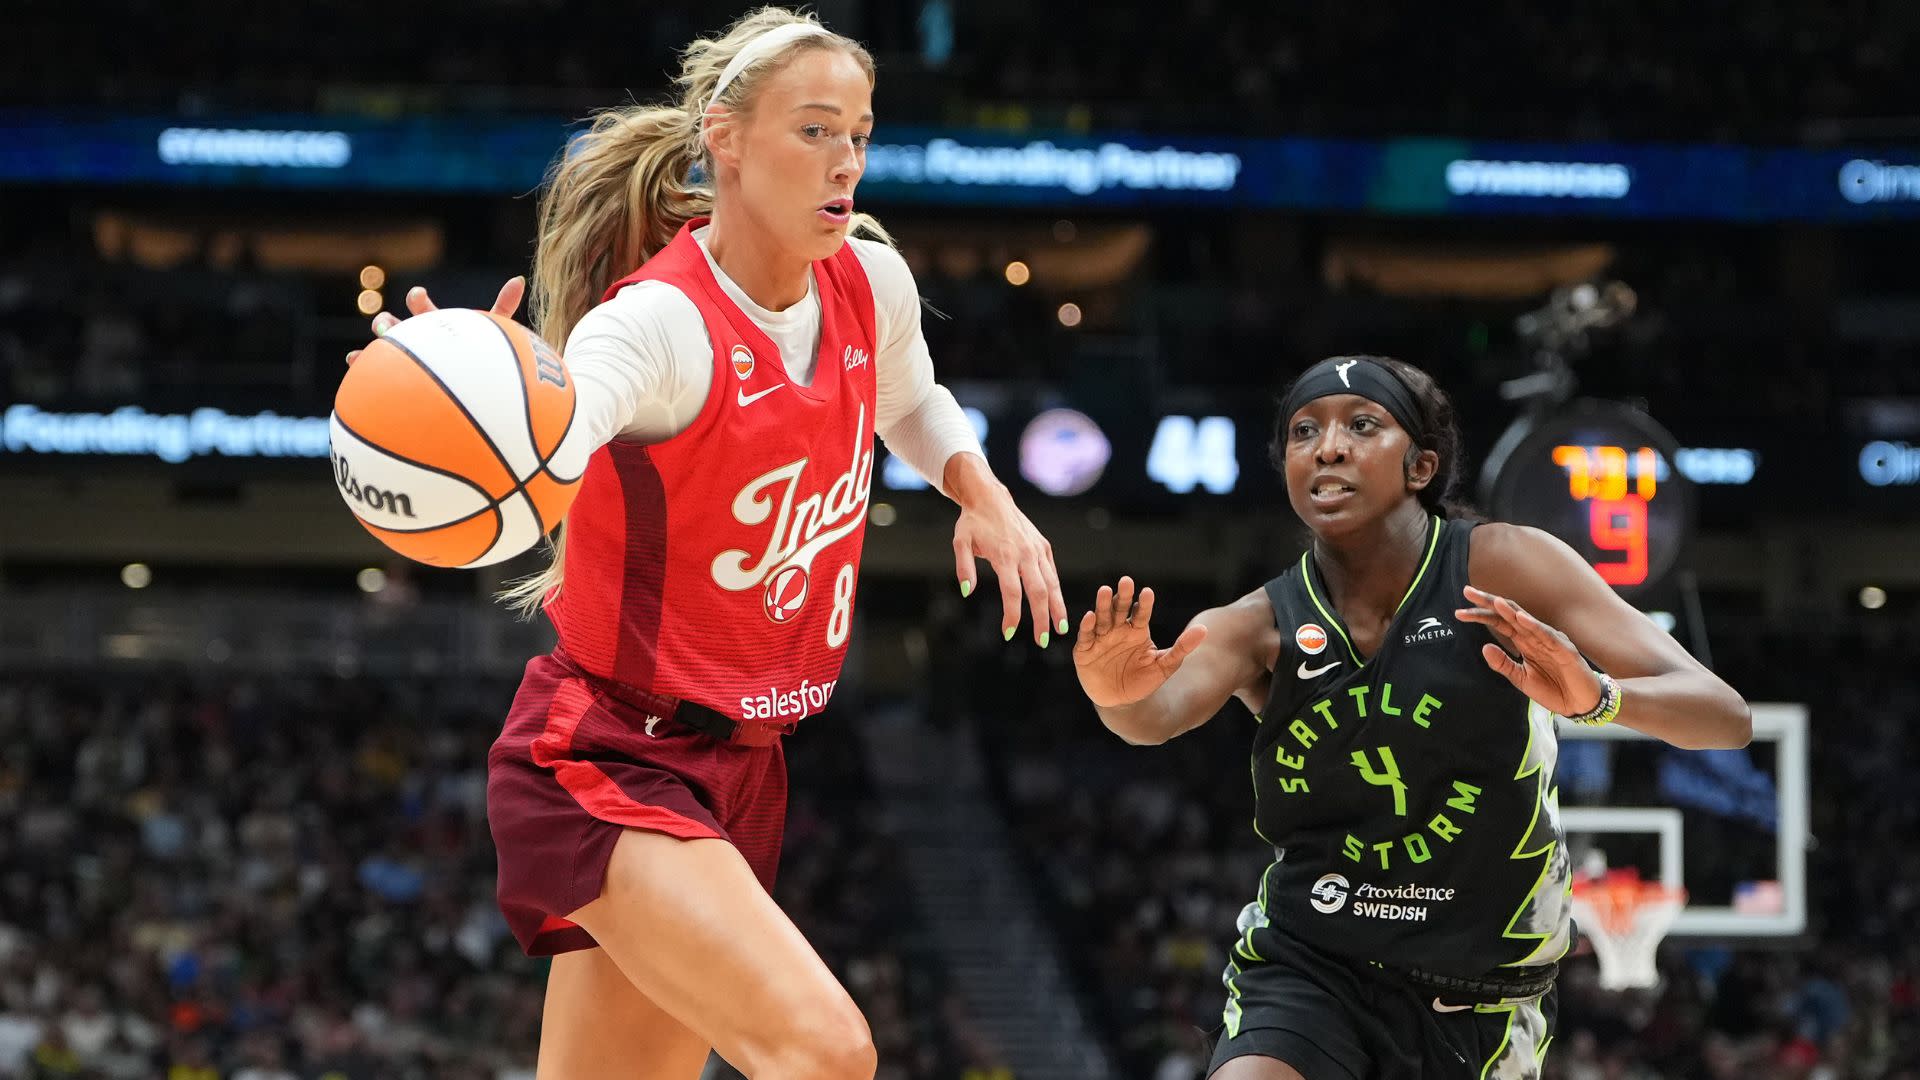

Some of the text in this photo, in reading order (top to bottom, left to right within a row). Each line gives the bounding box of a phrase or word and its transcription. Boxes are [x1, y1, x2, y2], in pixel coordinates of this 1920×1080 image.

[925, 138, 1098, 194] Founding
[1100, 142, 1242, 190] Partner
[329, 445, 417, 519] ilson
[1146, 415, 1240, 495] 44
[710, 401, 872, 592] Indy
[1589, 493, 1648, 586] 9
[826, 562, 854, 650] 8
[1404, 629, 1454, 644] SYMETRA
[740, 680, 837, 720] salesfor
[1276, 682, 1443, 793] SEATTLE
[1350, 745, 1408, 816] 4
[1342, 780, 1482, 870] STORM
[1353, 901, 1428, 922] SWEDISH
[1354, 883, 1455, 901] Providence
